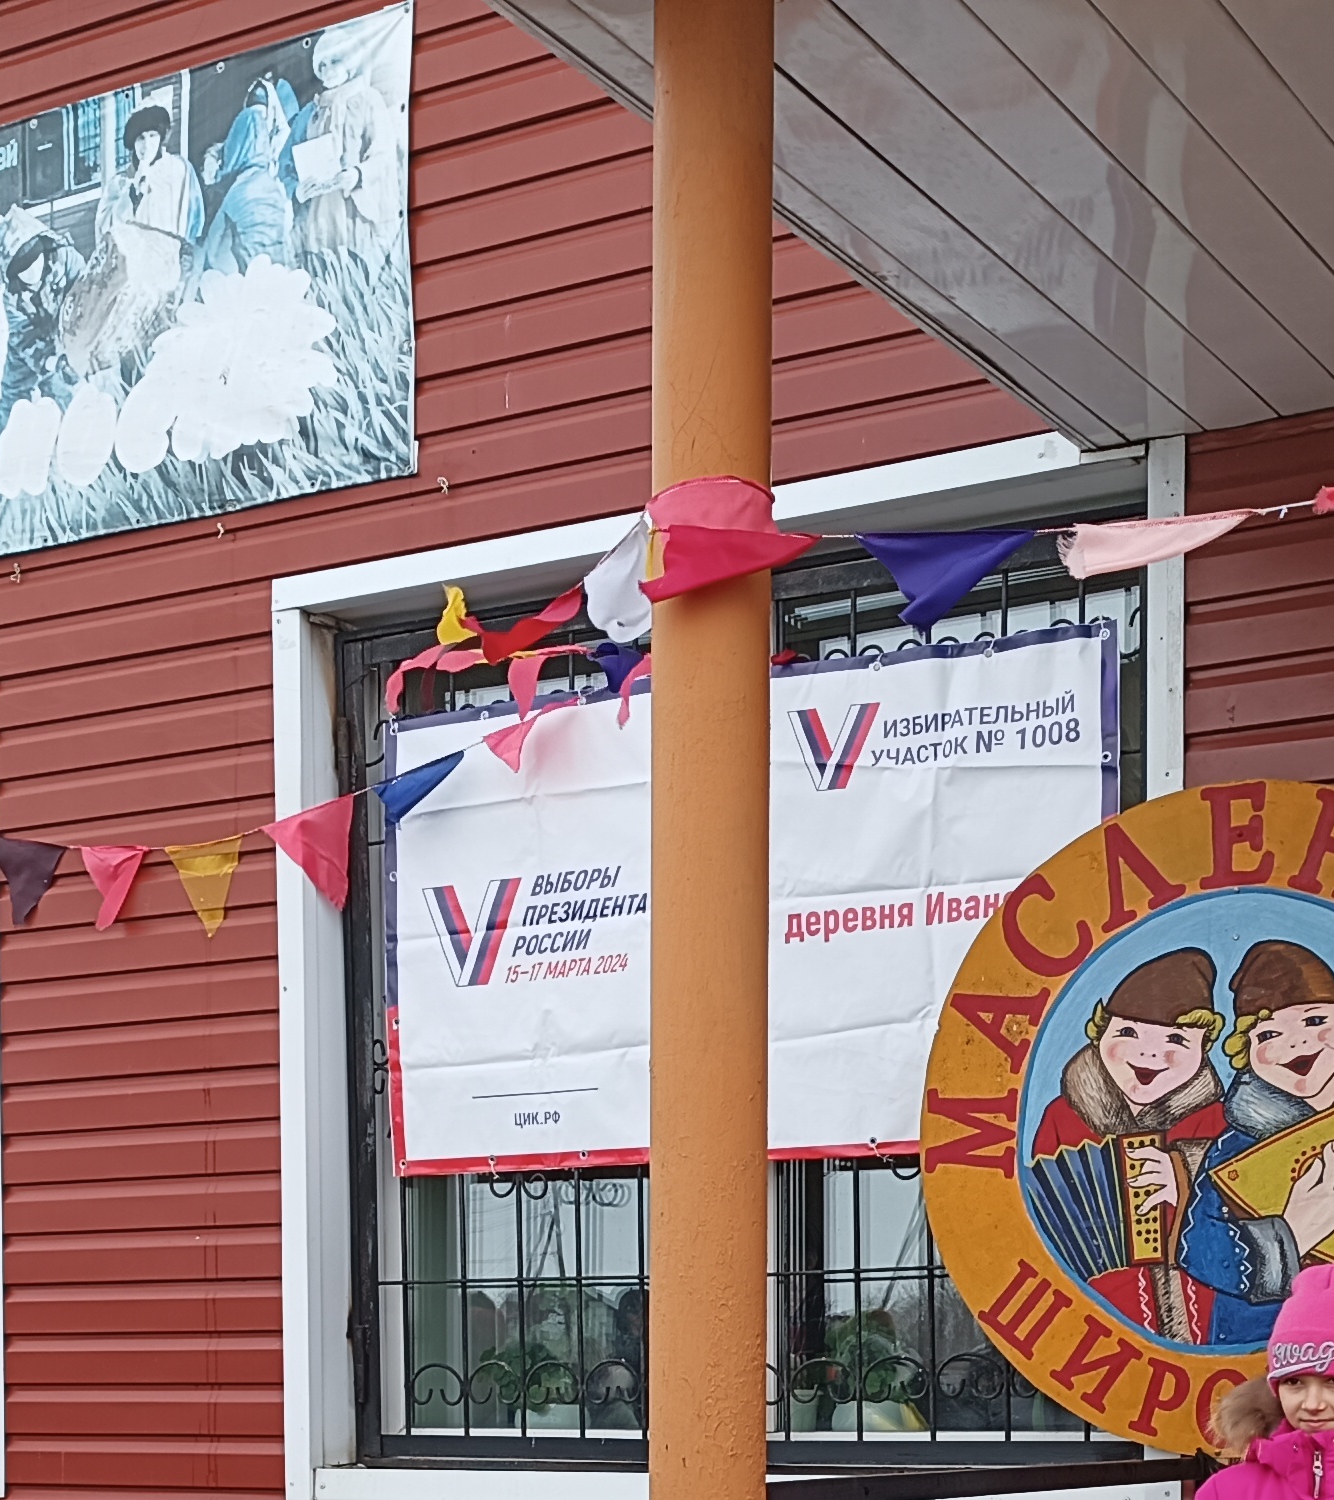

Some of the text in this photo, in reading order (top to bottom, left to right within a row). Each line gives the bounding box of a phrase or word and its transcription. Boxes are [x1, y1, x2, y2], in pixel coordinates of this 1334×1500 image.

[882, 690, 1077, 740] ИЗБИРАТЕЛЬНЫЙ
[870, 720, 1082, 767] УЧАСТОК № 1008
[531, 866, 621, 896] ВЫБОРЫ
[522, 893, 648, 927] ПРЕЗИДЕНТА
[784, 902, 914, 945] деревня
[511, 929, 592, 957] РОССИИ
[543, 957, 593, 980] МАРТА
[593, 952, 629, 975] 2024
[514, 1109, 561, 1129] ЦИК.РФ
